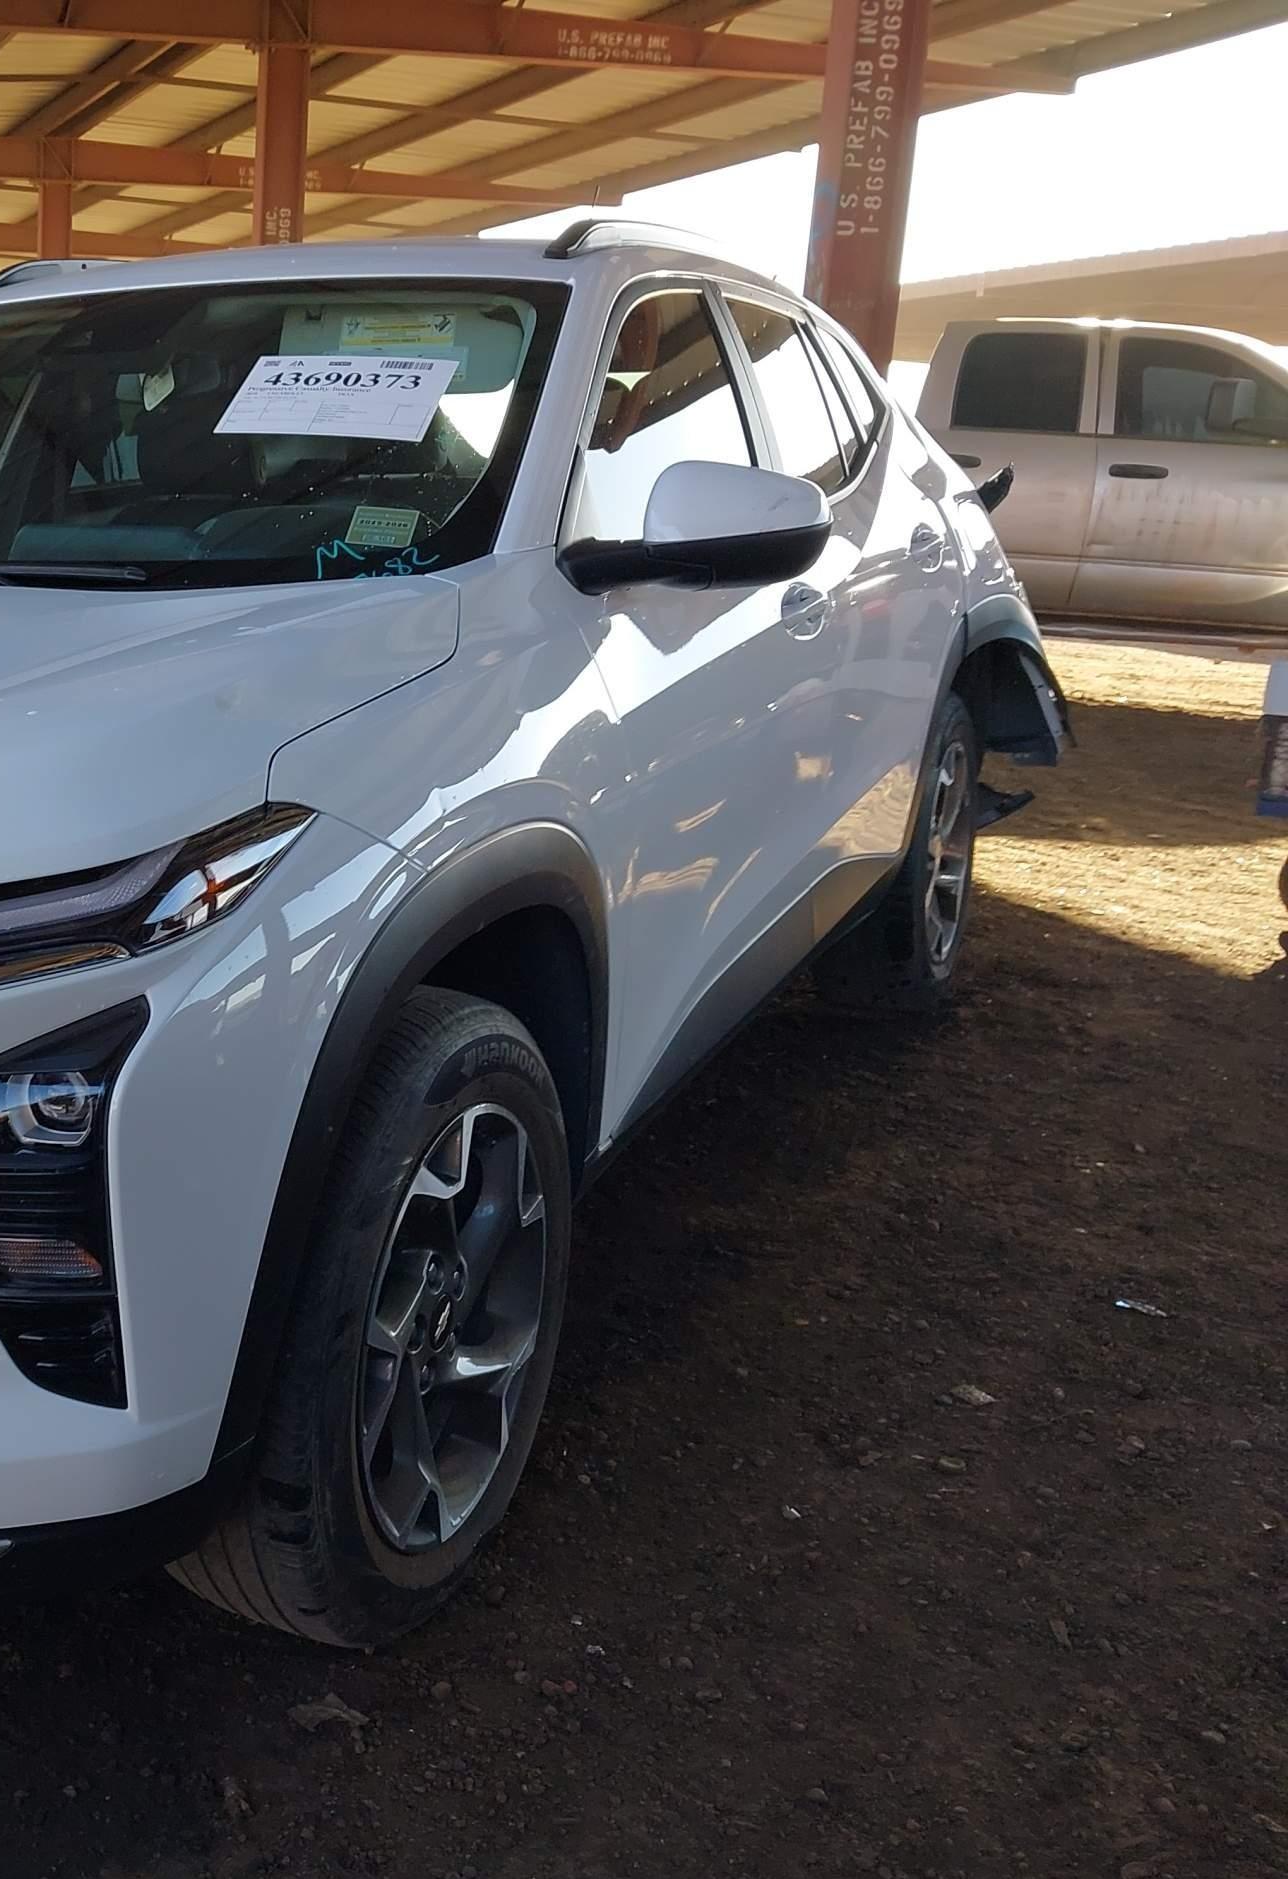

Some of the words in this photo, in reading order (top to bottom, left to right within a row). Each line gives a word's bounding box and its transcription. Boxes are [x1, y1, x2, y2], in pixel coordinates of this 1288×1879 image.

[590, 31, 642, 47] PREFAB
[844, 59, 874, 168] PREFAB
[860, 0, 905, 234] 1-866-799-0969
[263, 371, 422, 391] 43690373
